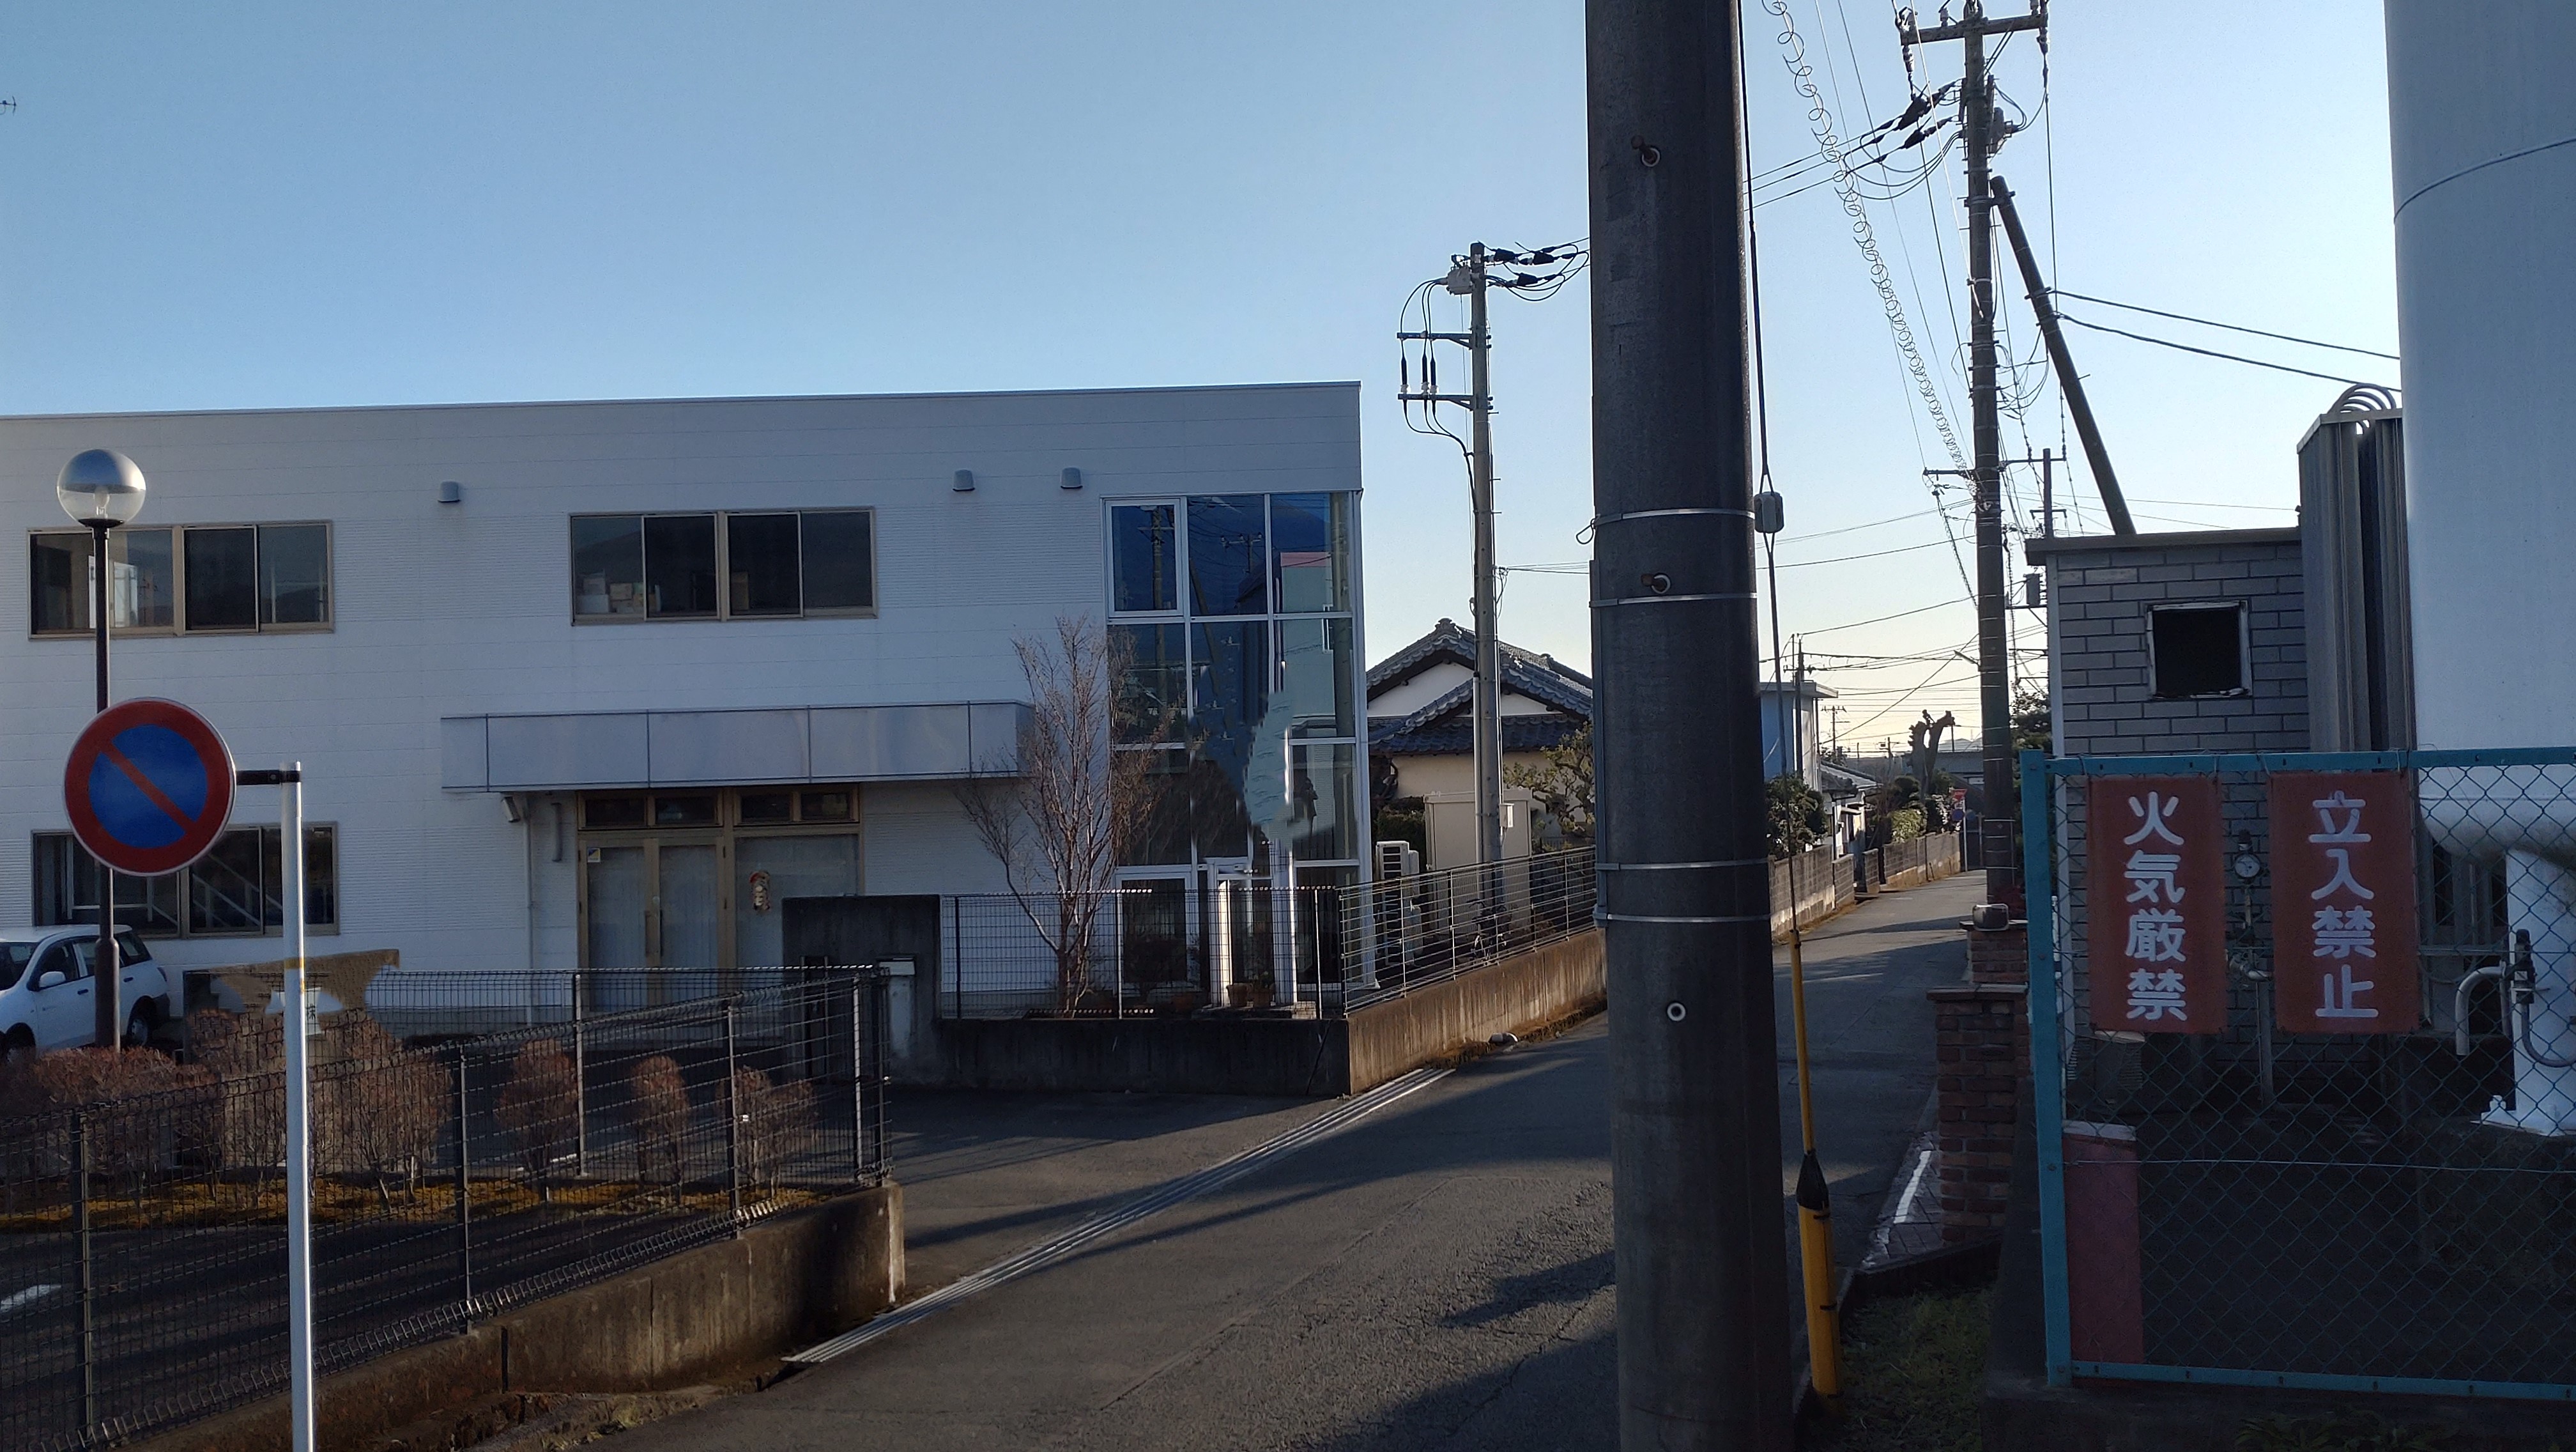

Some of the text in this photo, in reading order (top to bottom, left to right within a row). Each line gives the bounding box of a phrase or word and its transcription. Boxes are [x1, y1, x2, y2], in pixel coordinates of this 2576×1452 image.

[2123, 791, 2187, 1021] 火気厳禁
[2308, 789, 2380, 1019] 立入禁止
